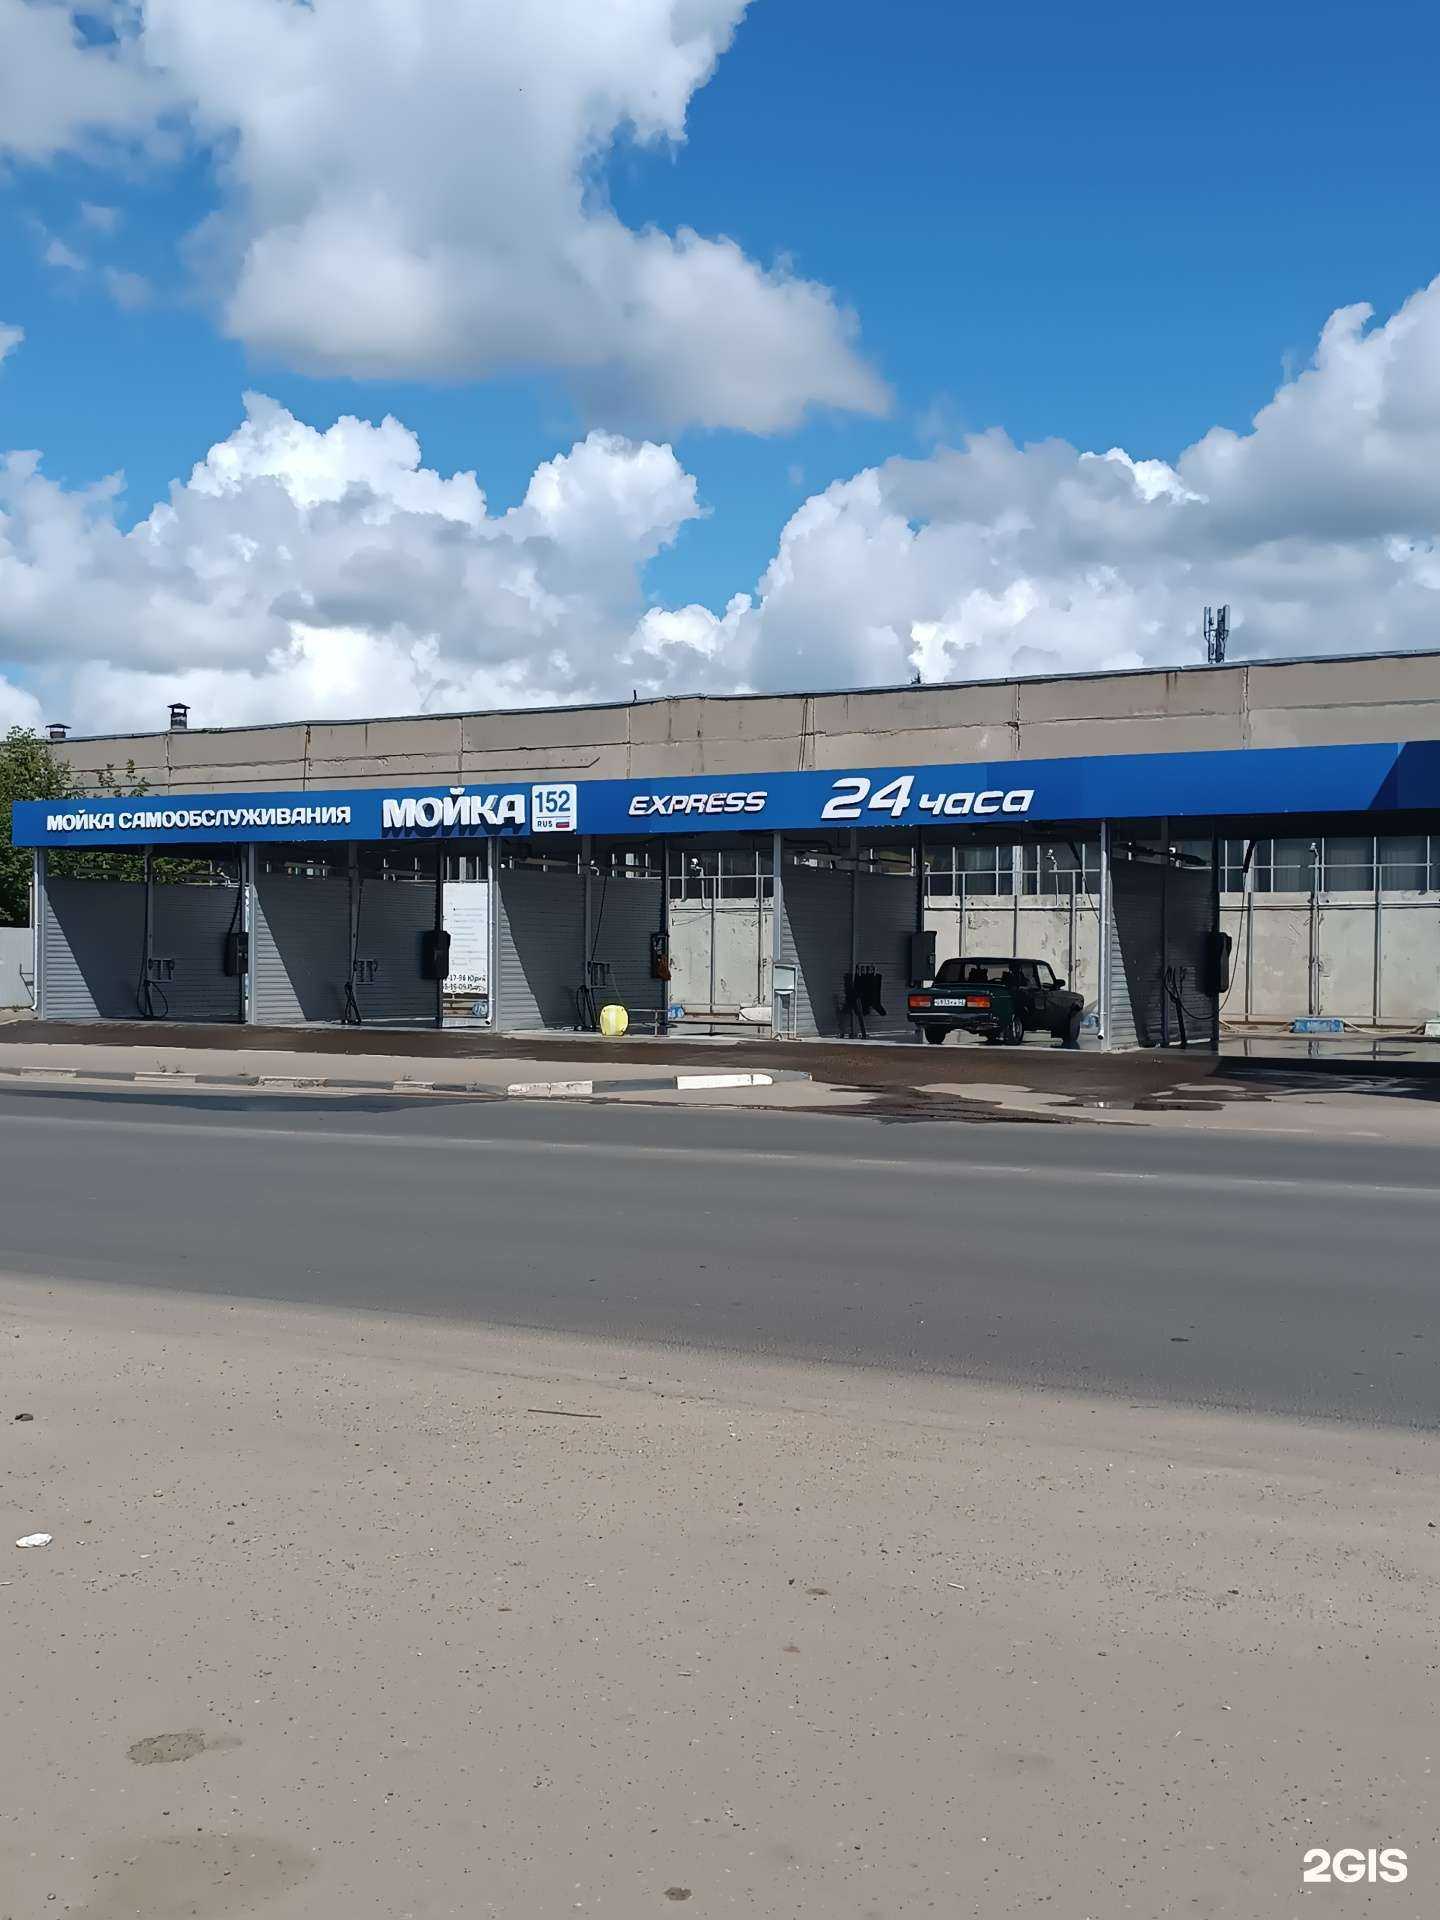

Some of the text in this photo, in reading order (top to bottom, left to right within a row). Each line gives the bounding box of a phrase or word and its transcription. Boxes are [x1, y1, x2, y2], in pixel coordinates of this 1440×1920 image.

[382, 786, 526, 828] МОЙКА
[535, 790, 571, 812] 152
[628, 791, 767, 816] EXPRESS
[821, 775, 1035, 818] 24 часа
[47, 806, 351, 831] МОЙКА САМООБСЛУЖИВАНИЯ
[537, 820, 553, 828] RUS
